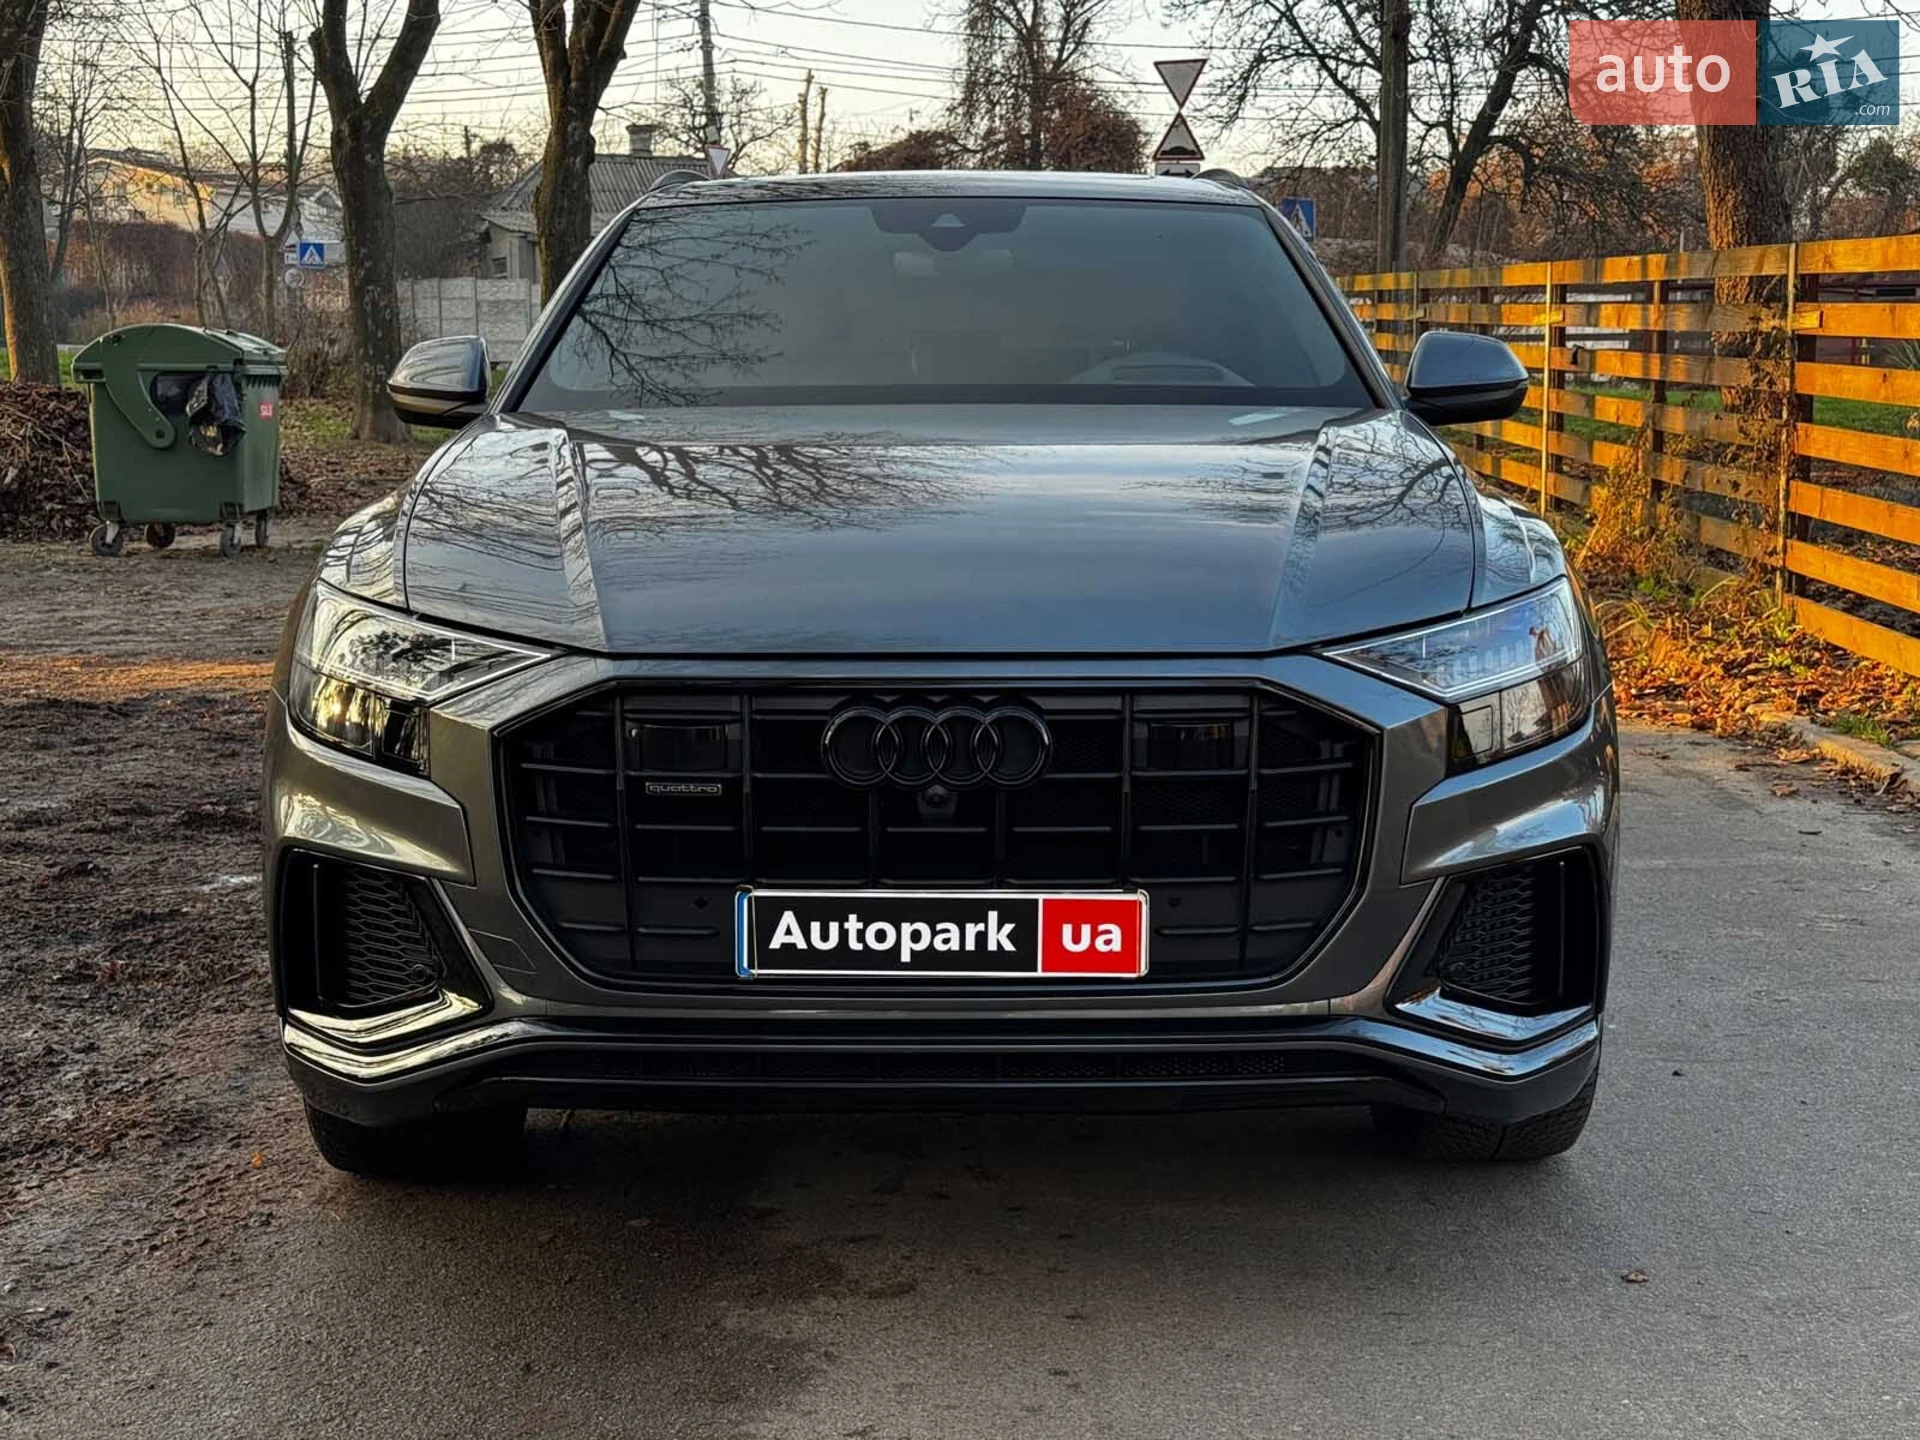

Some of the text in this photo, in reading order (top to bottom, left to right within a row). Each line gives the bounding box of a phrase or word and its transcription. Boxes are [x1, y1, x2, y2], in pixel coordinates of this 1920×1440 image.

[648, 784, 719, 794] quattro
[768, 910, 1123, 963] Autopark ua
